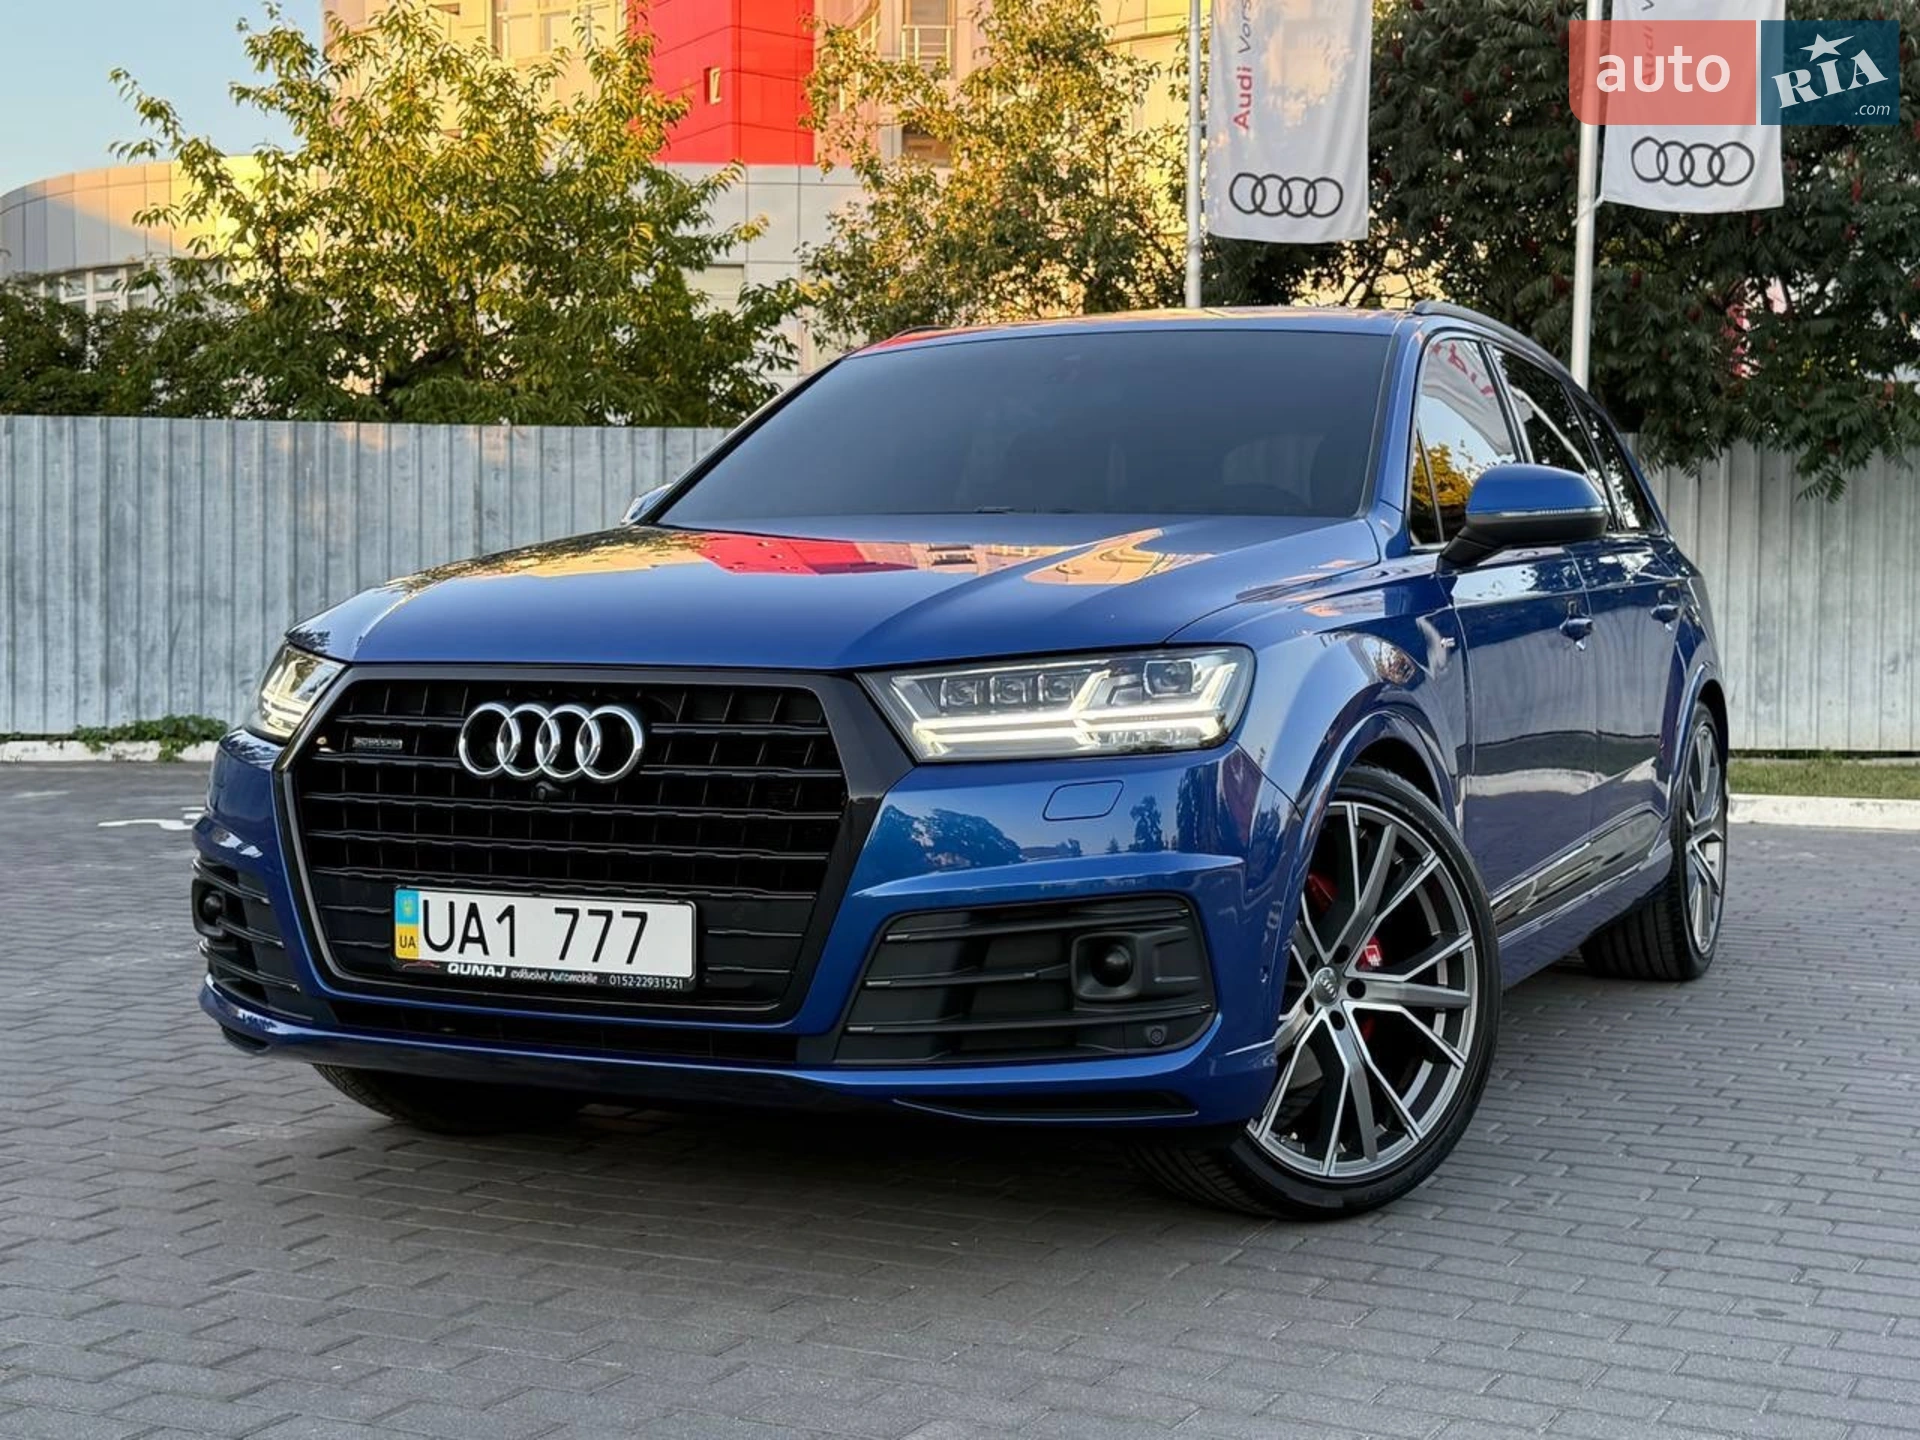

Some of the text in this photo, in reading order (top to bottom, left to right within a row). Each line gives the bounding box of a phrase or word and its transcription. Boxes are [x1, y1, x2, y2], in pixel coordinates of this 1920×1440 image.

[1233, 66, 1252, 130] Audi
[399, 936, 417, 949] UA
[422, 899, 649, 965] UA1 777
[608, 974, 684, 990] 0152-22931521
